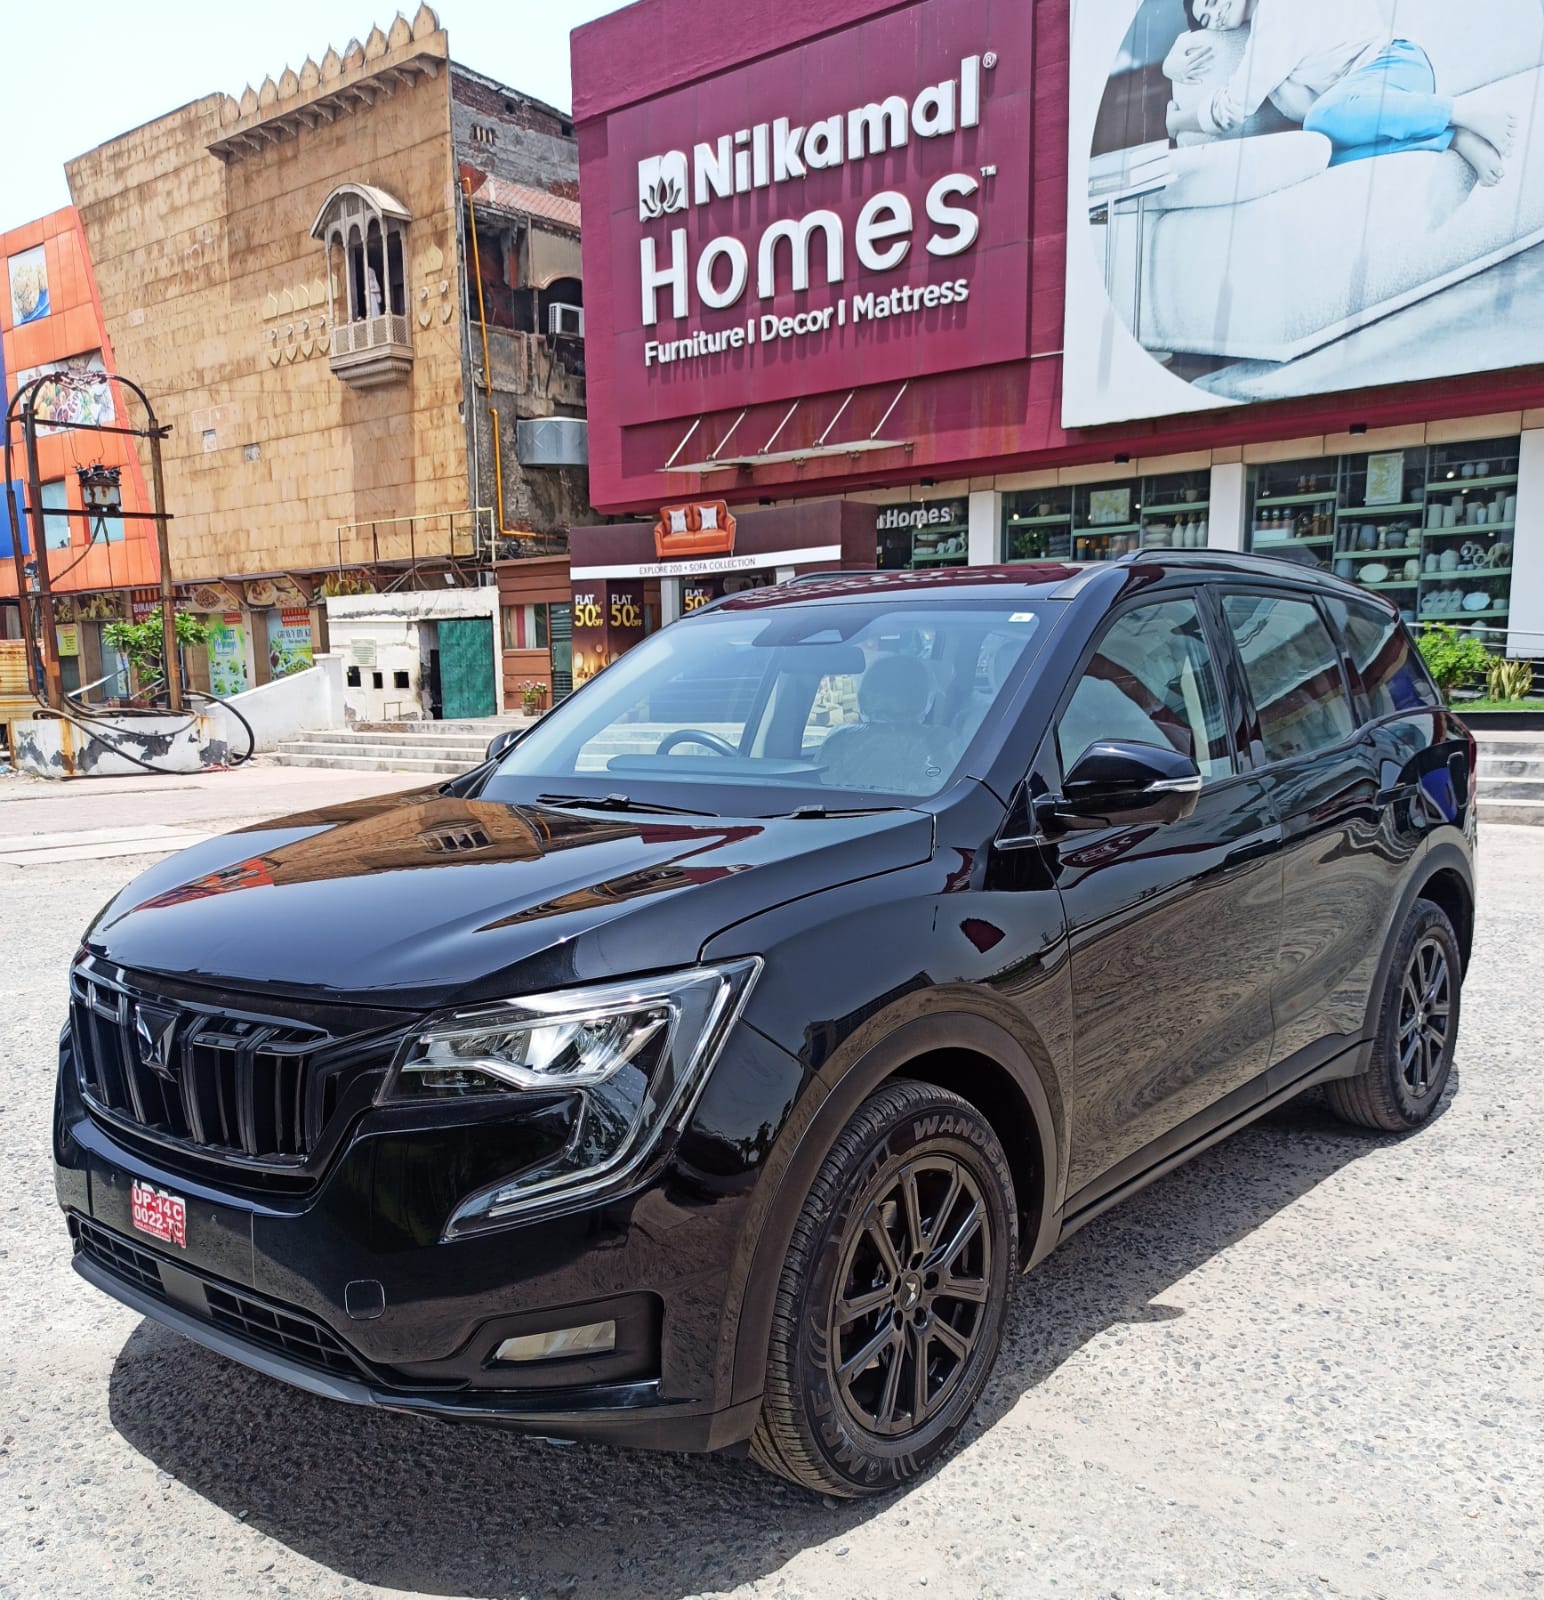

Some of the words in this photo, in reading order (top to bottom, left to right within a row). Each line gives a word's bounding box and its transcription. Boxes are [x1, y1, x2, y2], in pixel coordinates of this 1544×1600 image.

[693, 53, 980, 204] Nilkamal
[640, 172, 980, 326] Homes
[644, 326, 745, 367] Furniture
[760, 306, 834, 342] Decor
[853, 278, 970, 323] Mattress
[885, 506, 951, 529] Homes
[639, 565, 668, 575] EXPLORE
[689, 562, 707, 573] SOFA
[709, 558, 756, 571] COLLECTION
[575, 594, 595, 605] FLAT
[611, 594, 633, 605] FLAT
[684, 588, 704, 597] FLAT
[913, 1114, 1018, 1238] WANDERER
[134, 1205, 184, 1238] 0022-TC
